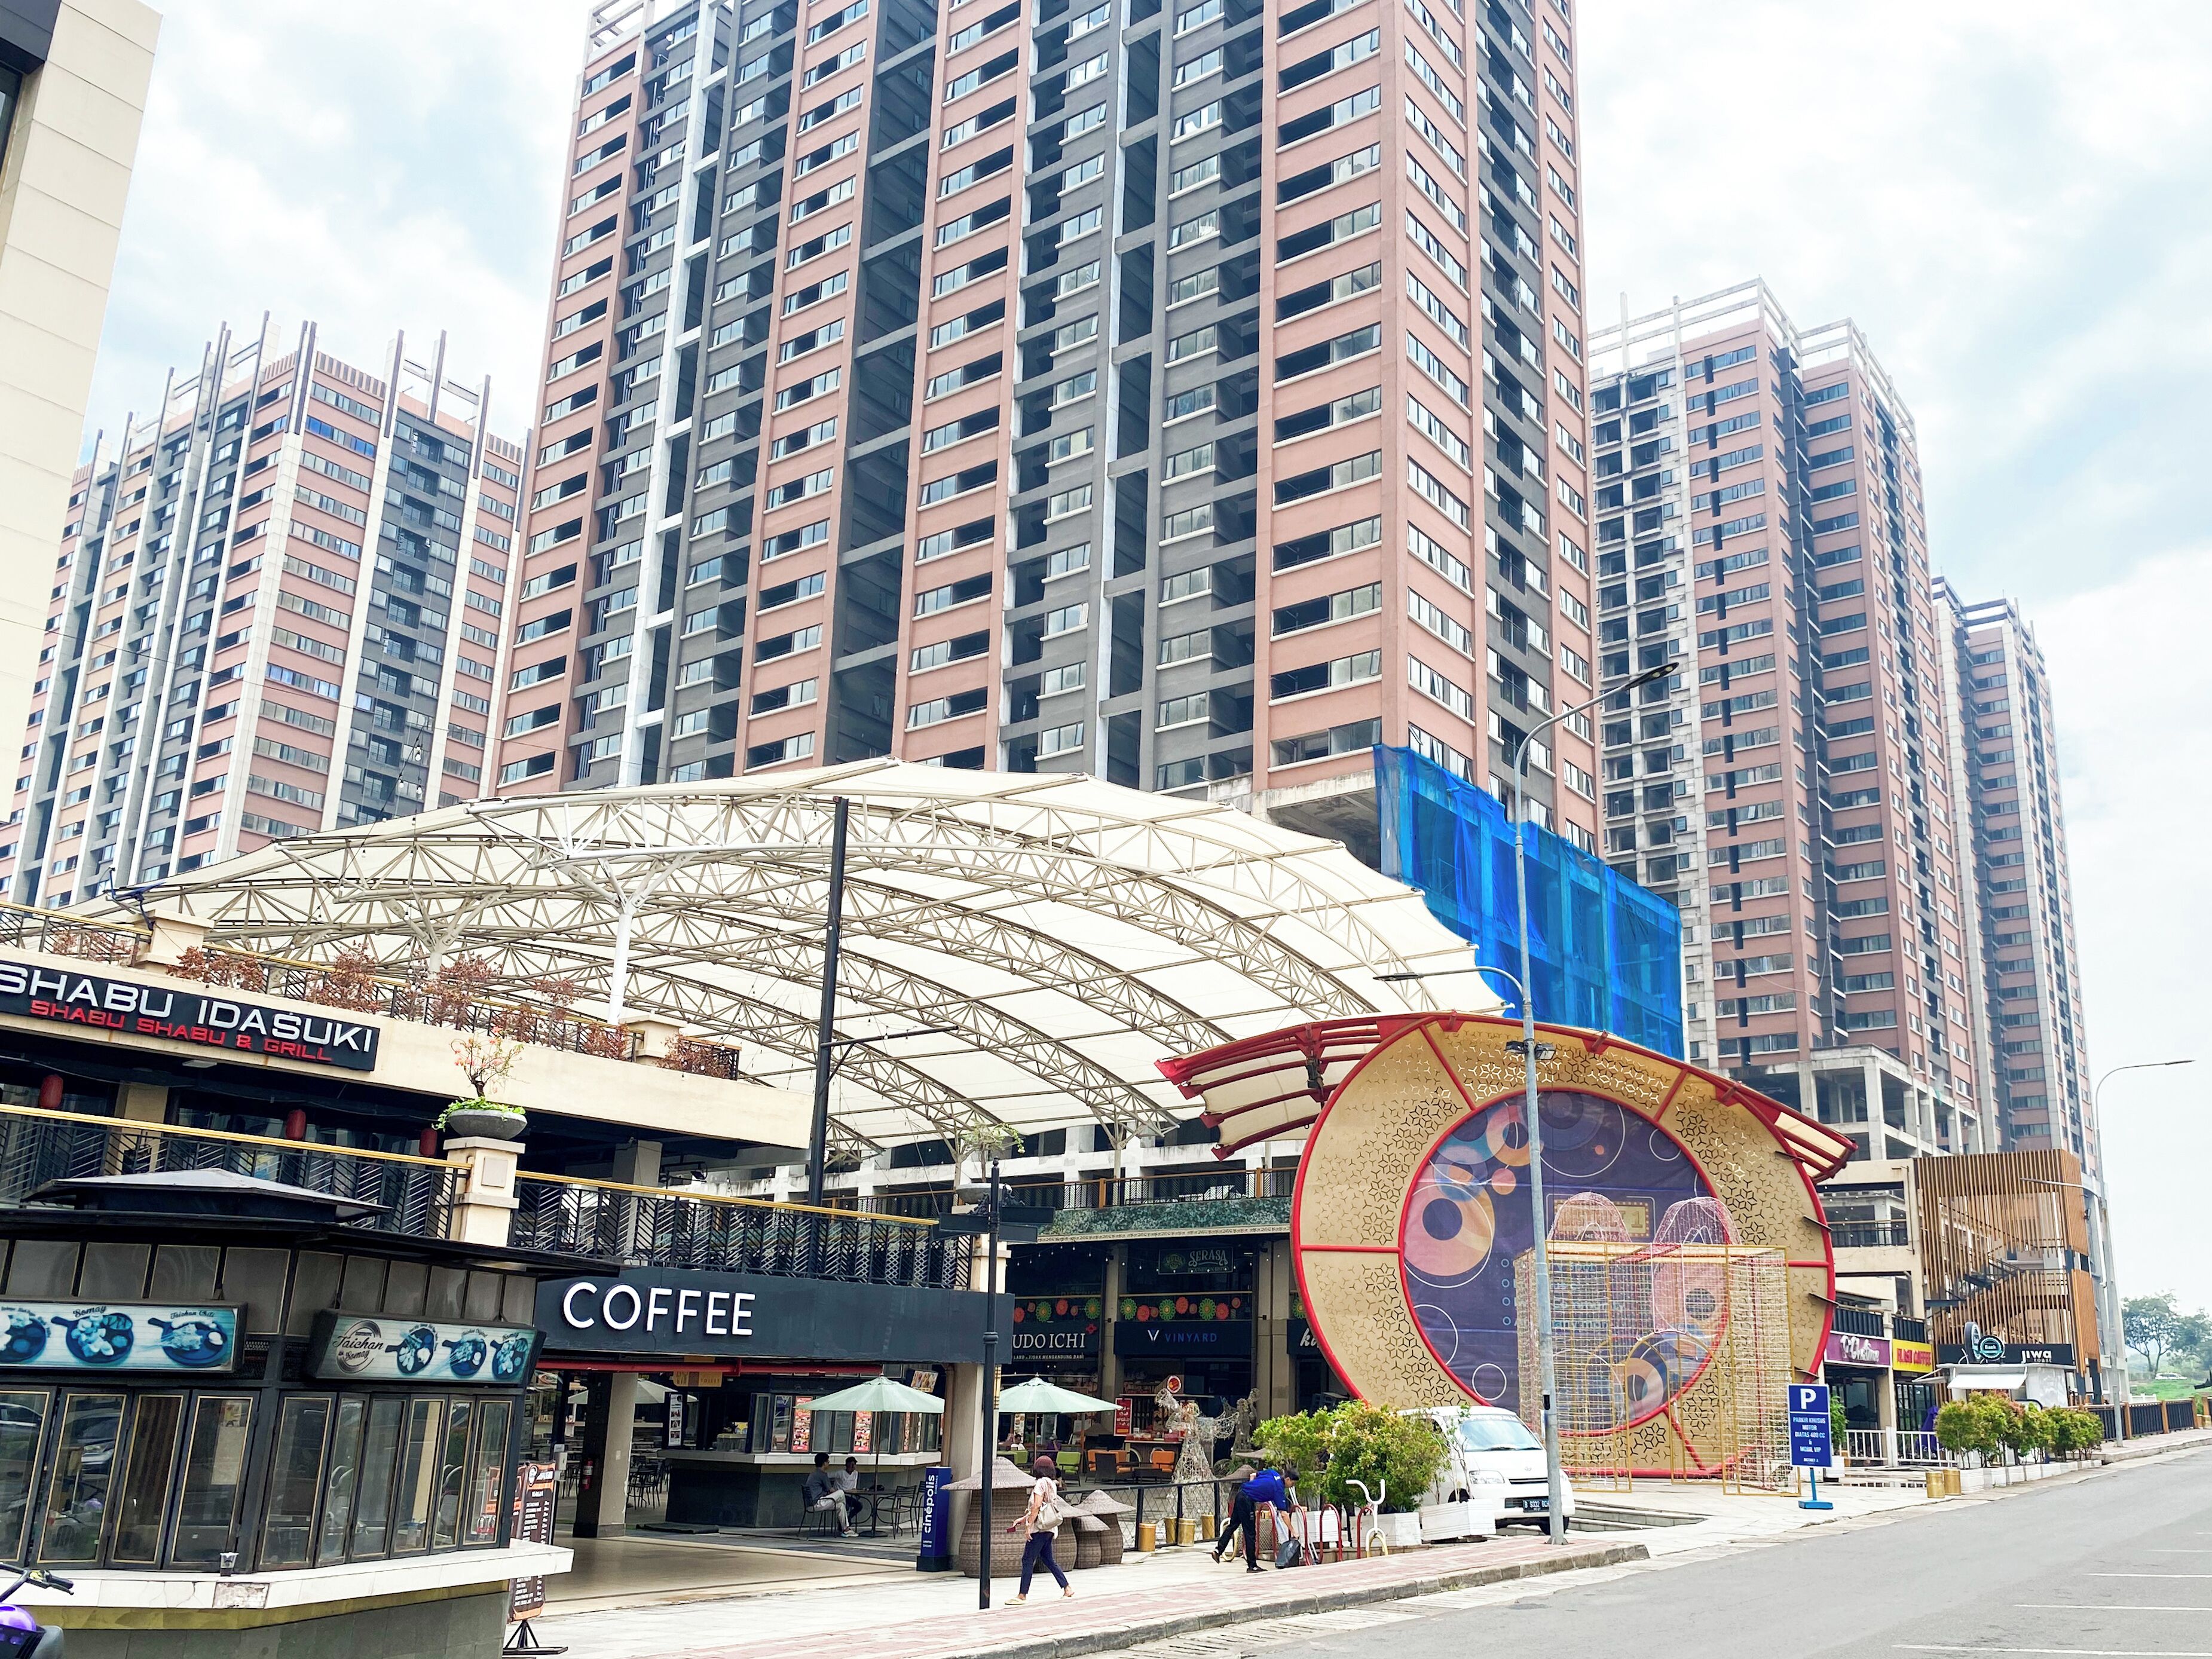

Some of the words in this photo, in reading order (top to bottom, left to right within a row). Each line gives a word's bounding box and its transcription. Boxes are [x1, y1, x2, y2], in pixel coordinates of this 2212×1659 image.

[0, 963, 173, 1018] SHABU
[197, 999, 372, 1052] IDASUKI
[30, 999, 125, 1029] SHABU
[136, 1018, 225, 1045] SHABU
[236, 1034, 252, 1049] &
[264, 1038, 332, 1061] GRILL
[1188, 1250, 1228, 1267] SERASA
[562, 1281, 755, 1335] COFFEE
[332, 1336, 385, 1351] Taichan
[1049, 1333, 1085, 1348] ICHI
[1165, 1333, 1217, 1342] VINYARD
[1800, 1388, 1816, 1410] P
[923, 1475, 934, 1533] cinépolis
